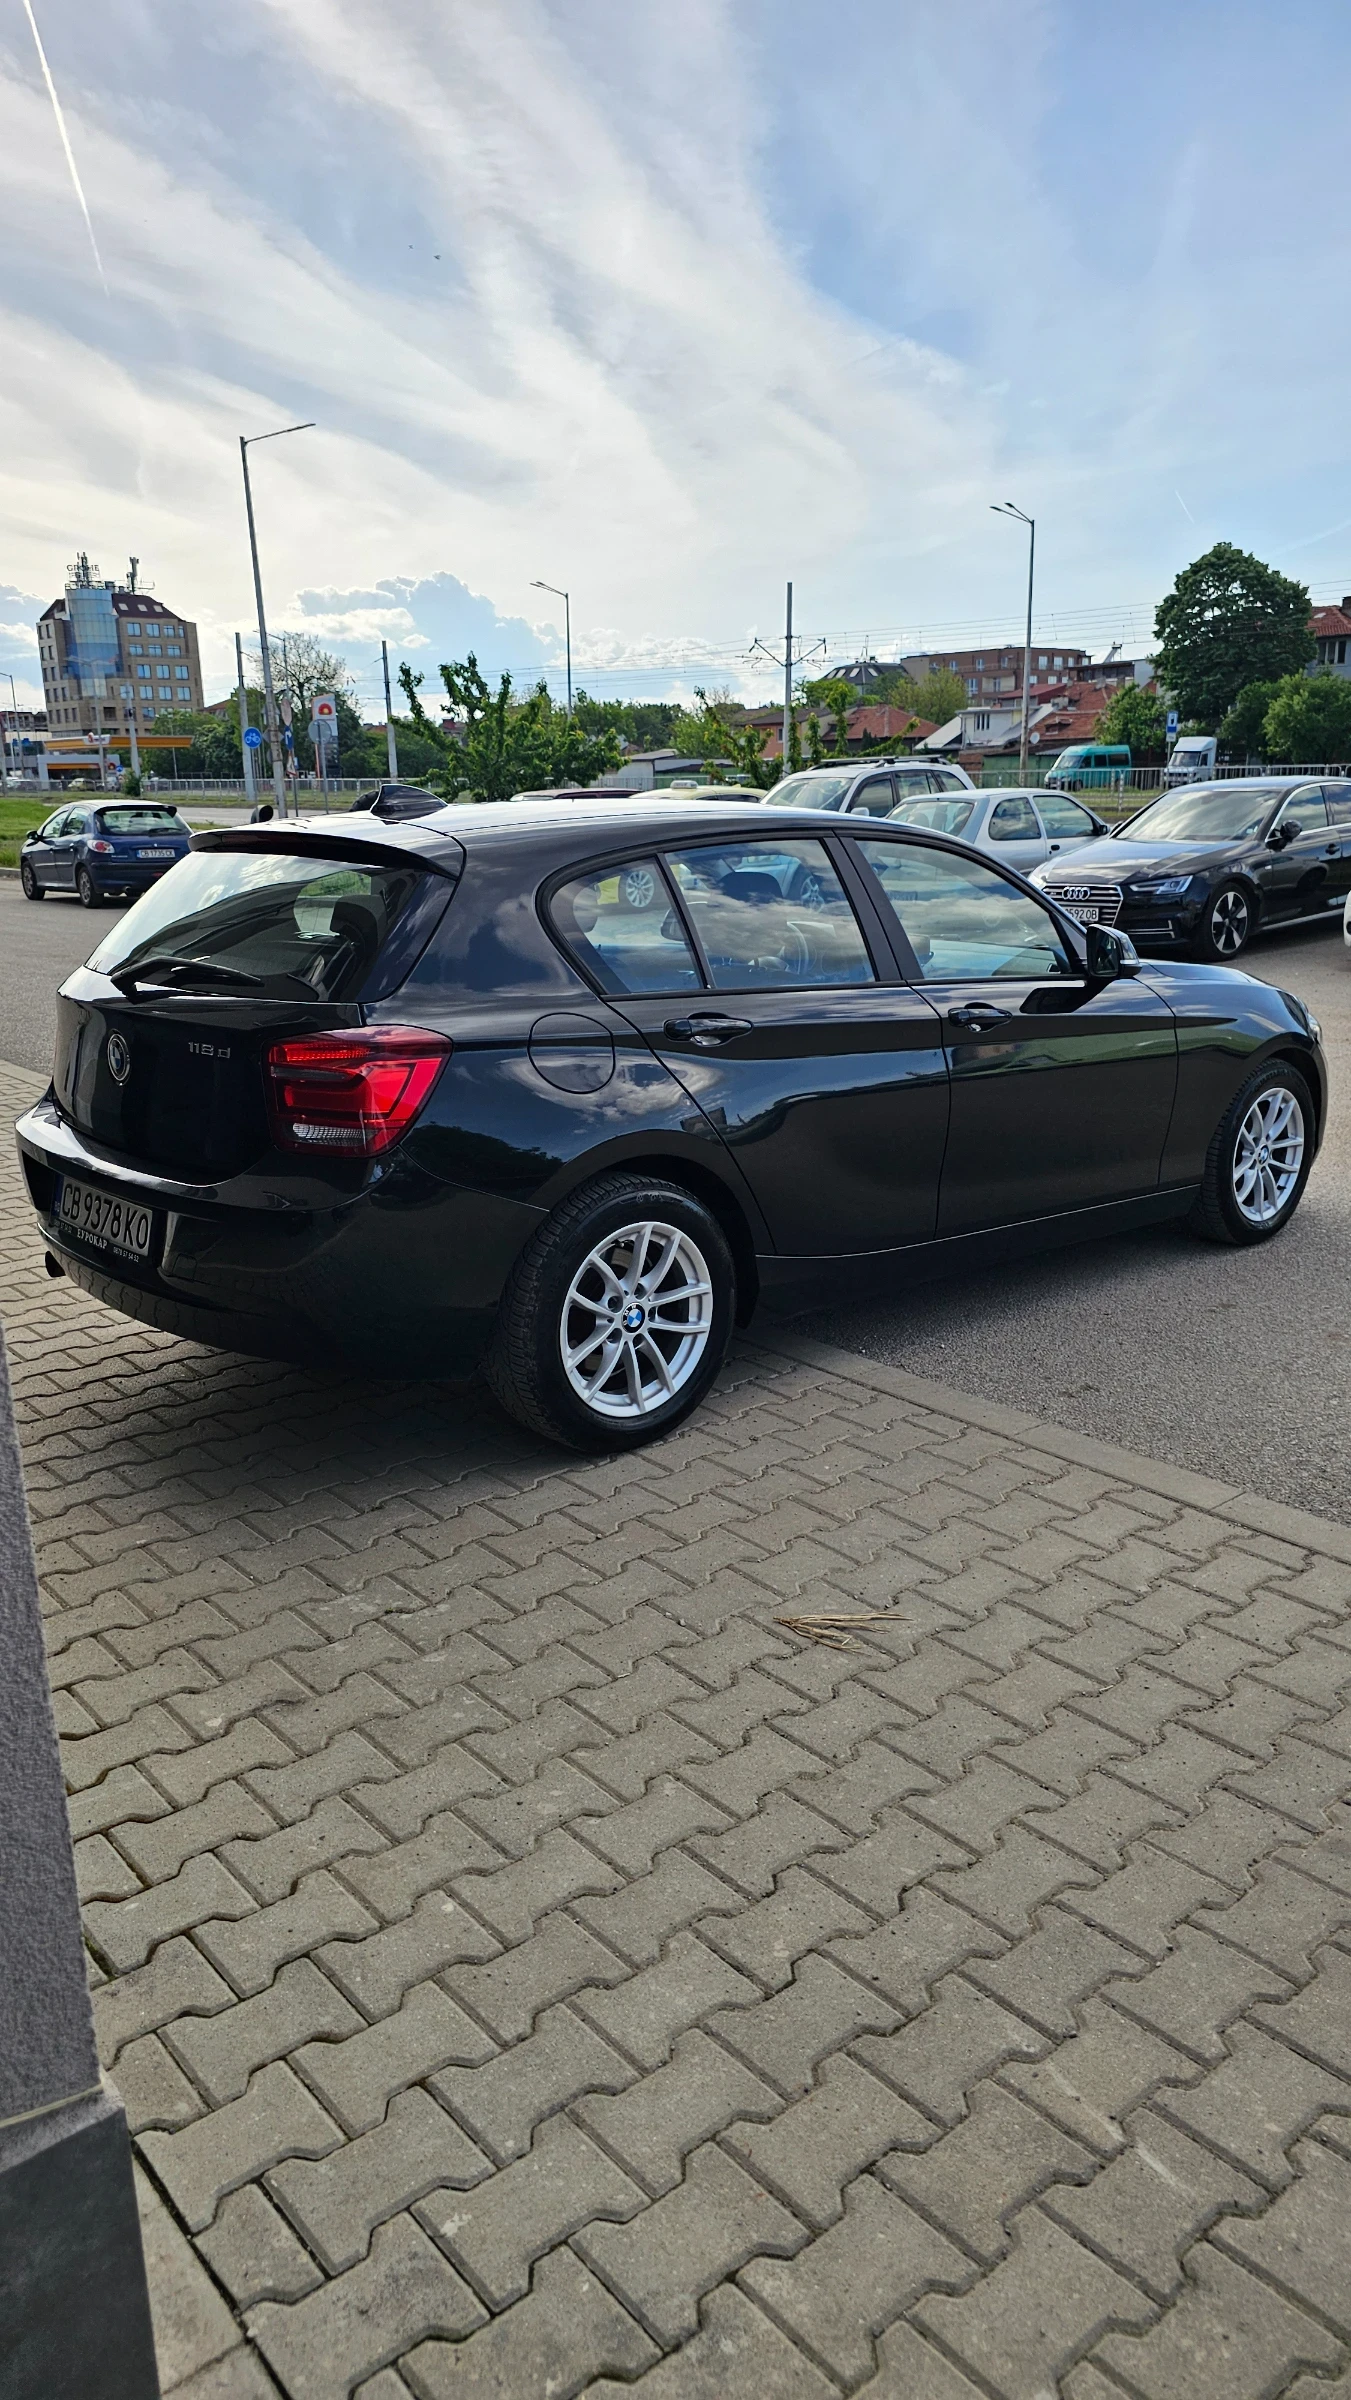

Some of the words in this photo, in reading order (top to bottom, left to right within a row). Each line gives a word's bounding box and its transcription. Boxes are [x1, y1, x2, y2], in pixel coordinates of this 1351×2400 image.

[66, 564, 100, 572] GRHE
[62, 1183, 81, 1221] CB
[84, 1192, 122, 1239] 9378
